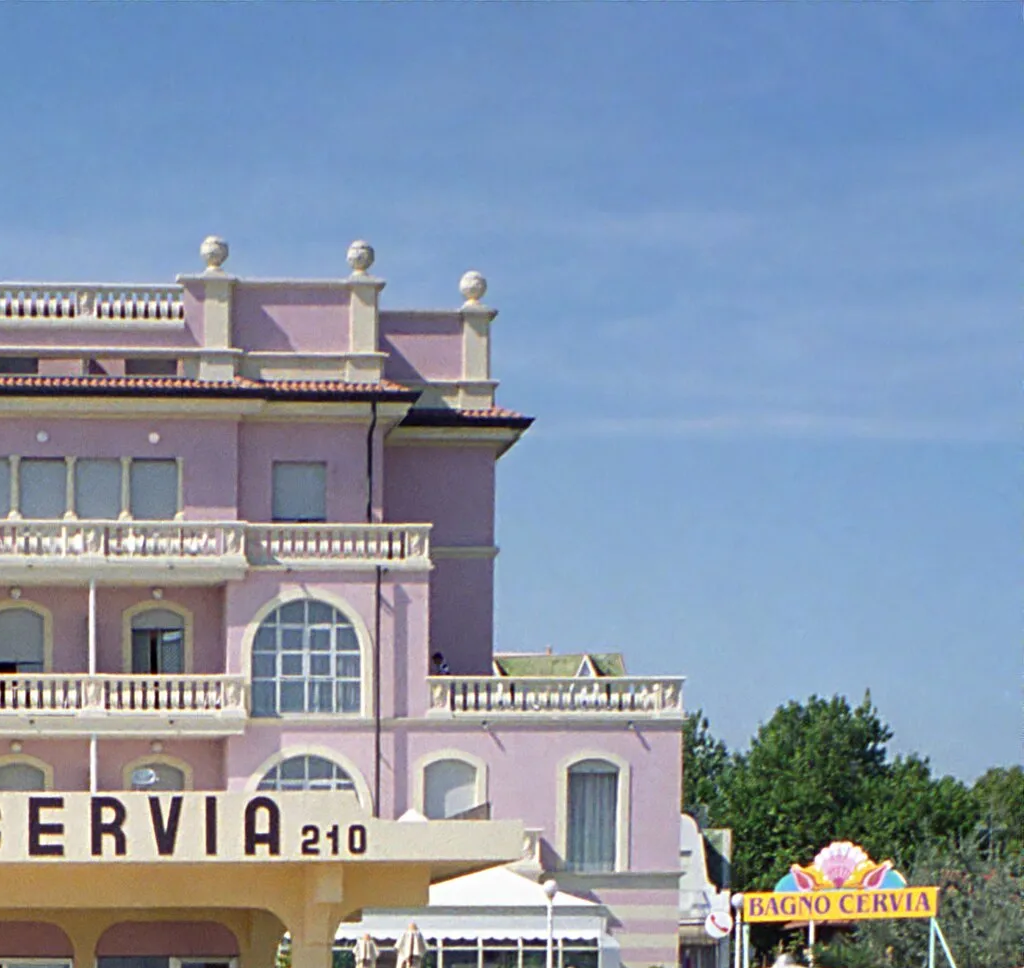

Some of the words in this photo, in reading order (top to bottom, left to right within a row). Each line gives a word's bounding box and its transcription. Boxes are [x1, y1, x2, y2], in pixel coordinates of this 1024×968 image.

[300, 823, 367, 855] 210
[748, 895, 831, 916] BAGNO
[839, 891, 931, 914] CERVIA
